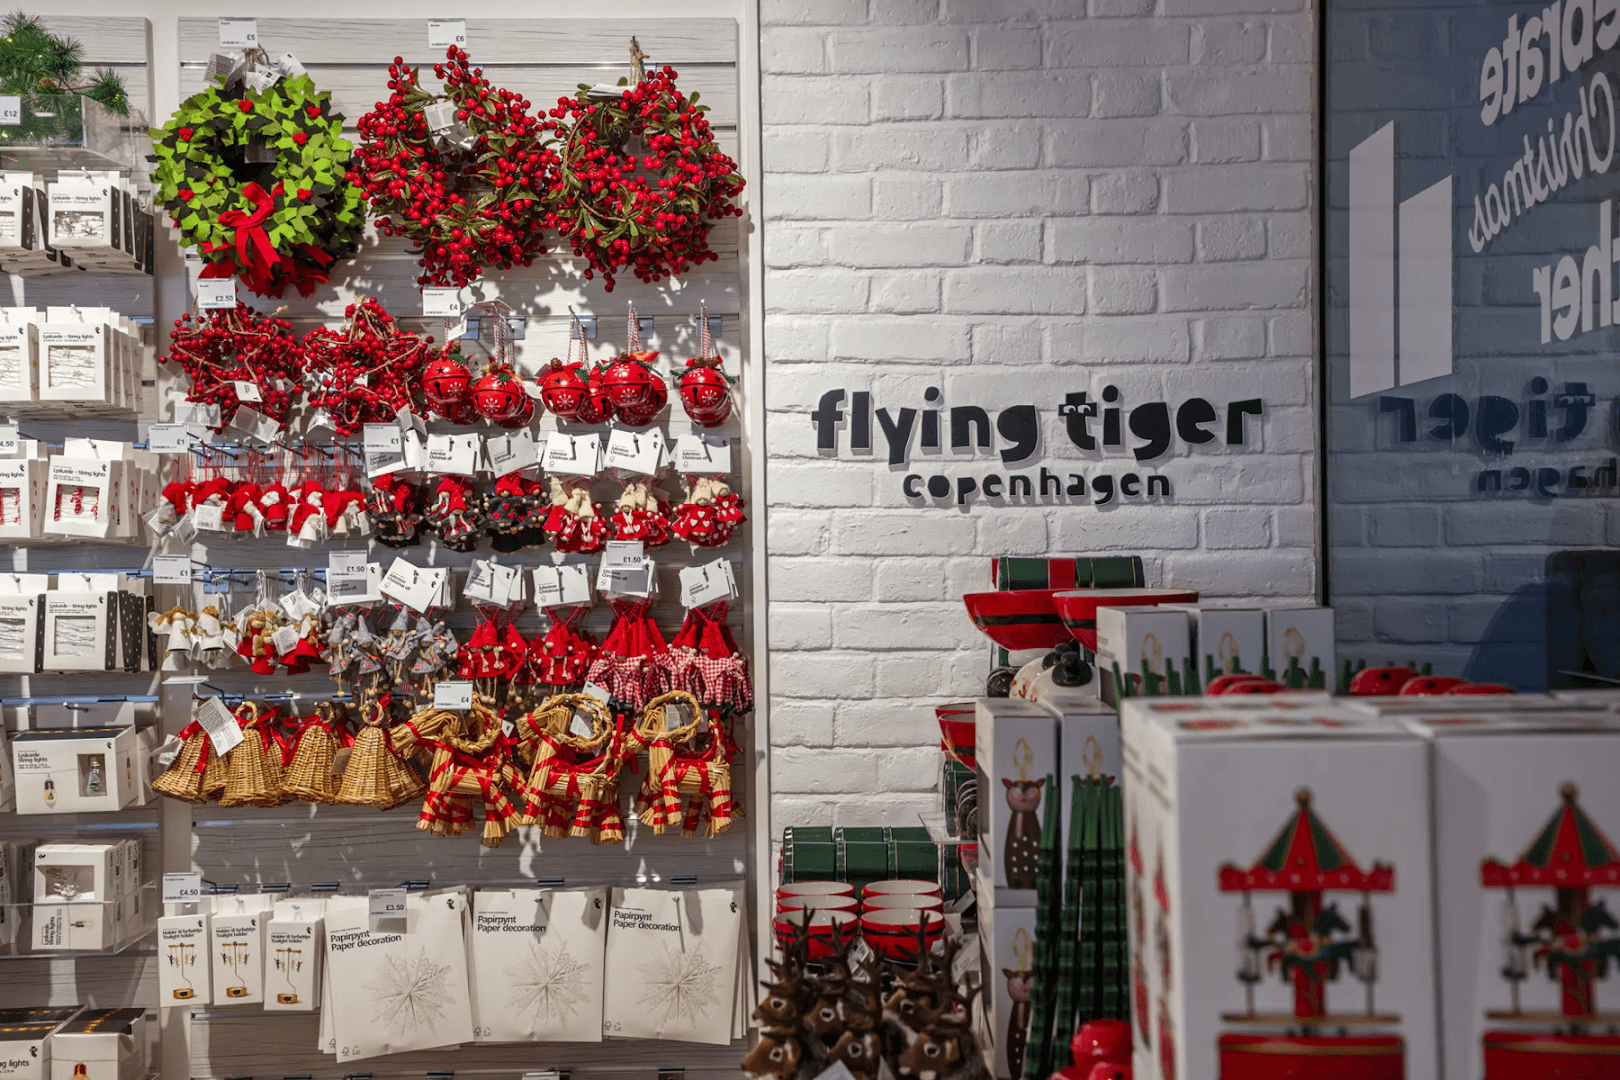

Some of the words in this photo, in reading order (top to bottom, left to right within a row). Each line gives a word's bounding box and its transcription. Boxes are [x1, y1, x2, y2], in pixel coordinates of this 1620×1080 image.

[811, 386, 1040, 465] flying
[1058, 384, 1264, 462] tiger
[902, 466, 1171, 505] copenhagen
[478, 915, 517, 926] Papirpynt
[614, 911, 652, 922] Papirpynt
[478, 924, 501, 934] Paper
[503, 924, 546, 932] decoration
[614, 919, 636, 930] Paper
[638, 921, 681, 932] decoration
[330, 930, 370, 944] Papirpynt
[332, 942, 355, 952] Paper
[357, 935, 402, 948] decoration
[9, 1059, 30, 1069] lights
